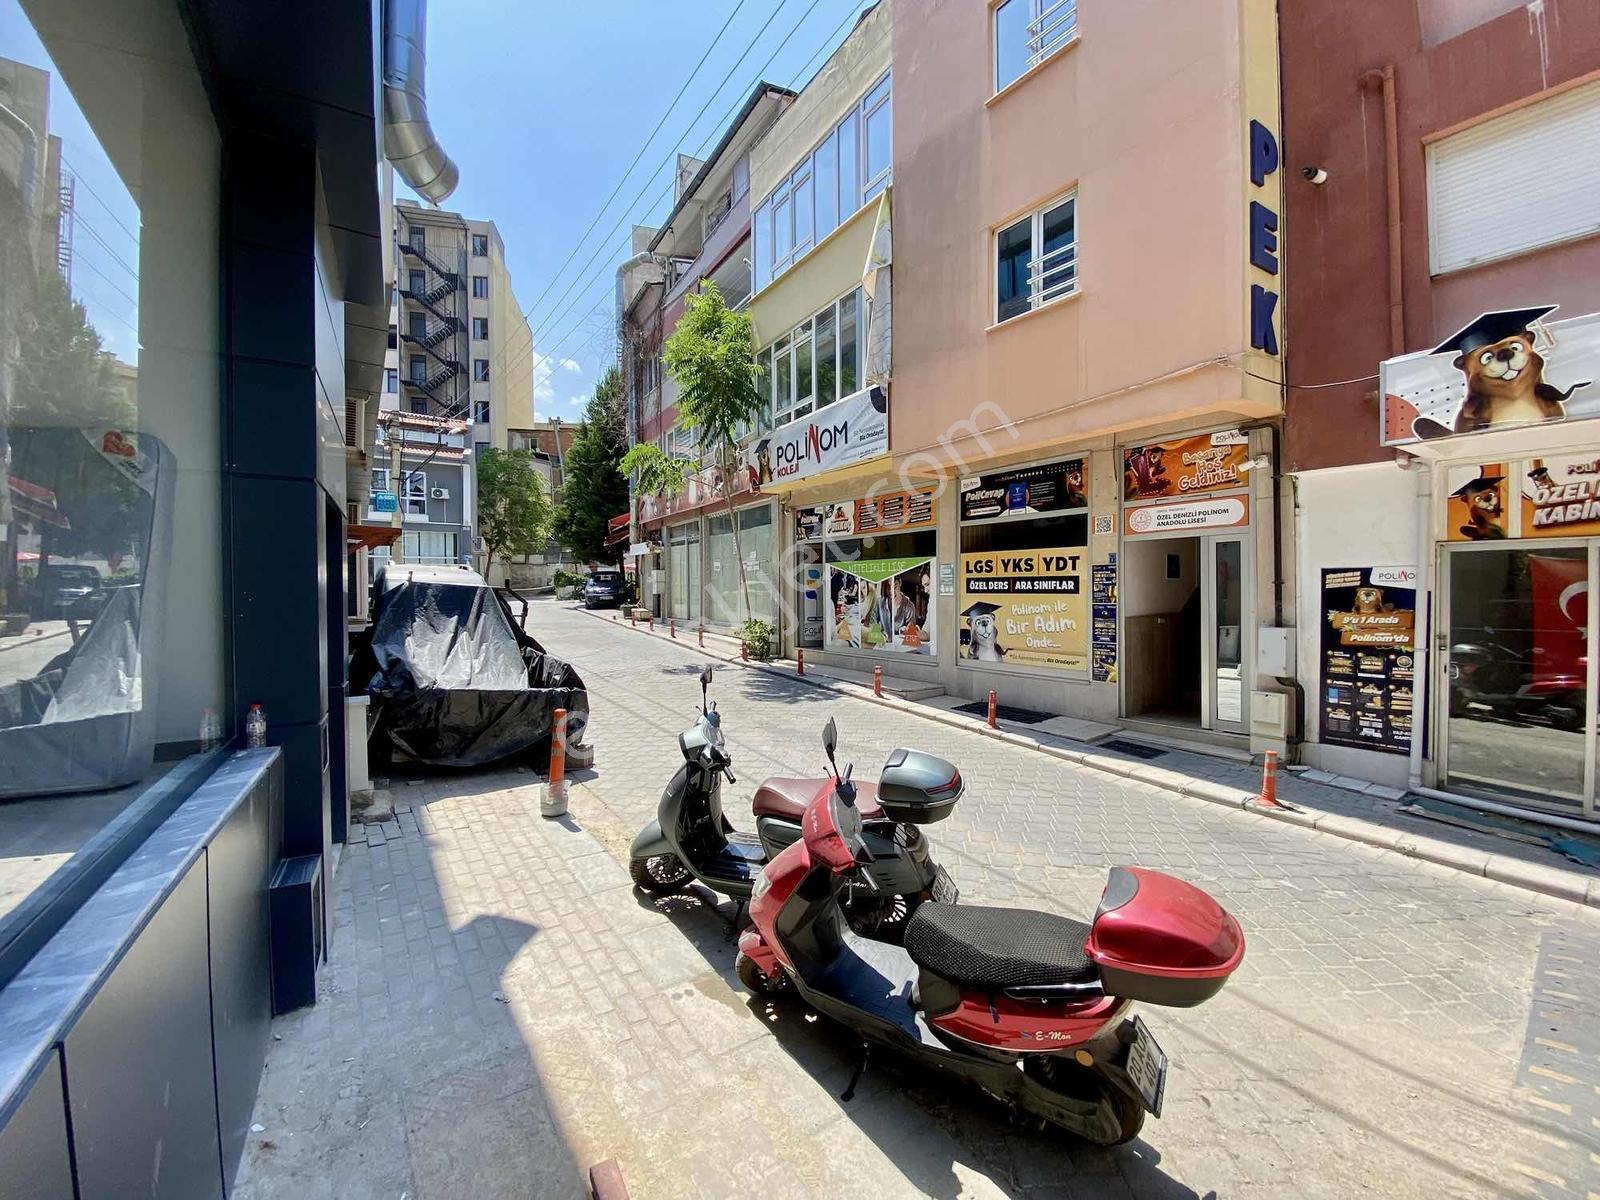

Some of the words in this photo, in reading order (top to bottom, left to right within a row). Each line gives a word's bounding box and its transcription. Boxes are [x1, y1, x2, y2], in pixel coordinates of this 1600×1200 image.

[1250, 119, 1278, 356] PEK
[1182, 446, 1232, 465] Başarıya
[1196, 459, 1222, 474] Hoş
[1178, 464, 1237, 491] Geldiniz!
[1533, 482, 1590, 505] ÖZEL
[1156, 513, 1172, 521] ÖZEL
[1198, 508, 1229, 517] POLİNOM
[1156, 519, 1187, 527] ANADOLU
[966, 559, 994, 574] LGS
[1001, 557, 1034, 573] YKS
[1042, 555, 1080, 571] YDT
[969, 580, 988, 590] ÖZEL
[989, 581, 1009, 590] DERS
[1015, 581, 1032, 590] ARA
[1033, 580, 1075, 590] SINIFLAR
[1011, 602, 1051, 616] Polinom
[1054, 600, 1068, 612] ile
[1006, 618, 1029, 634] Bir
[1034, 616, 1077, 633] Adım
[1366, 616, 1399, 624] Arada
[1129, 1062, 1141, 1086] 20
